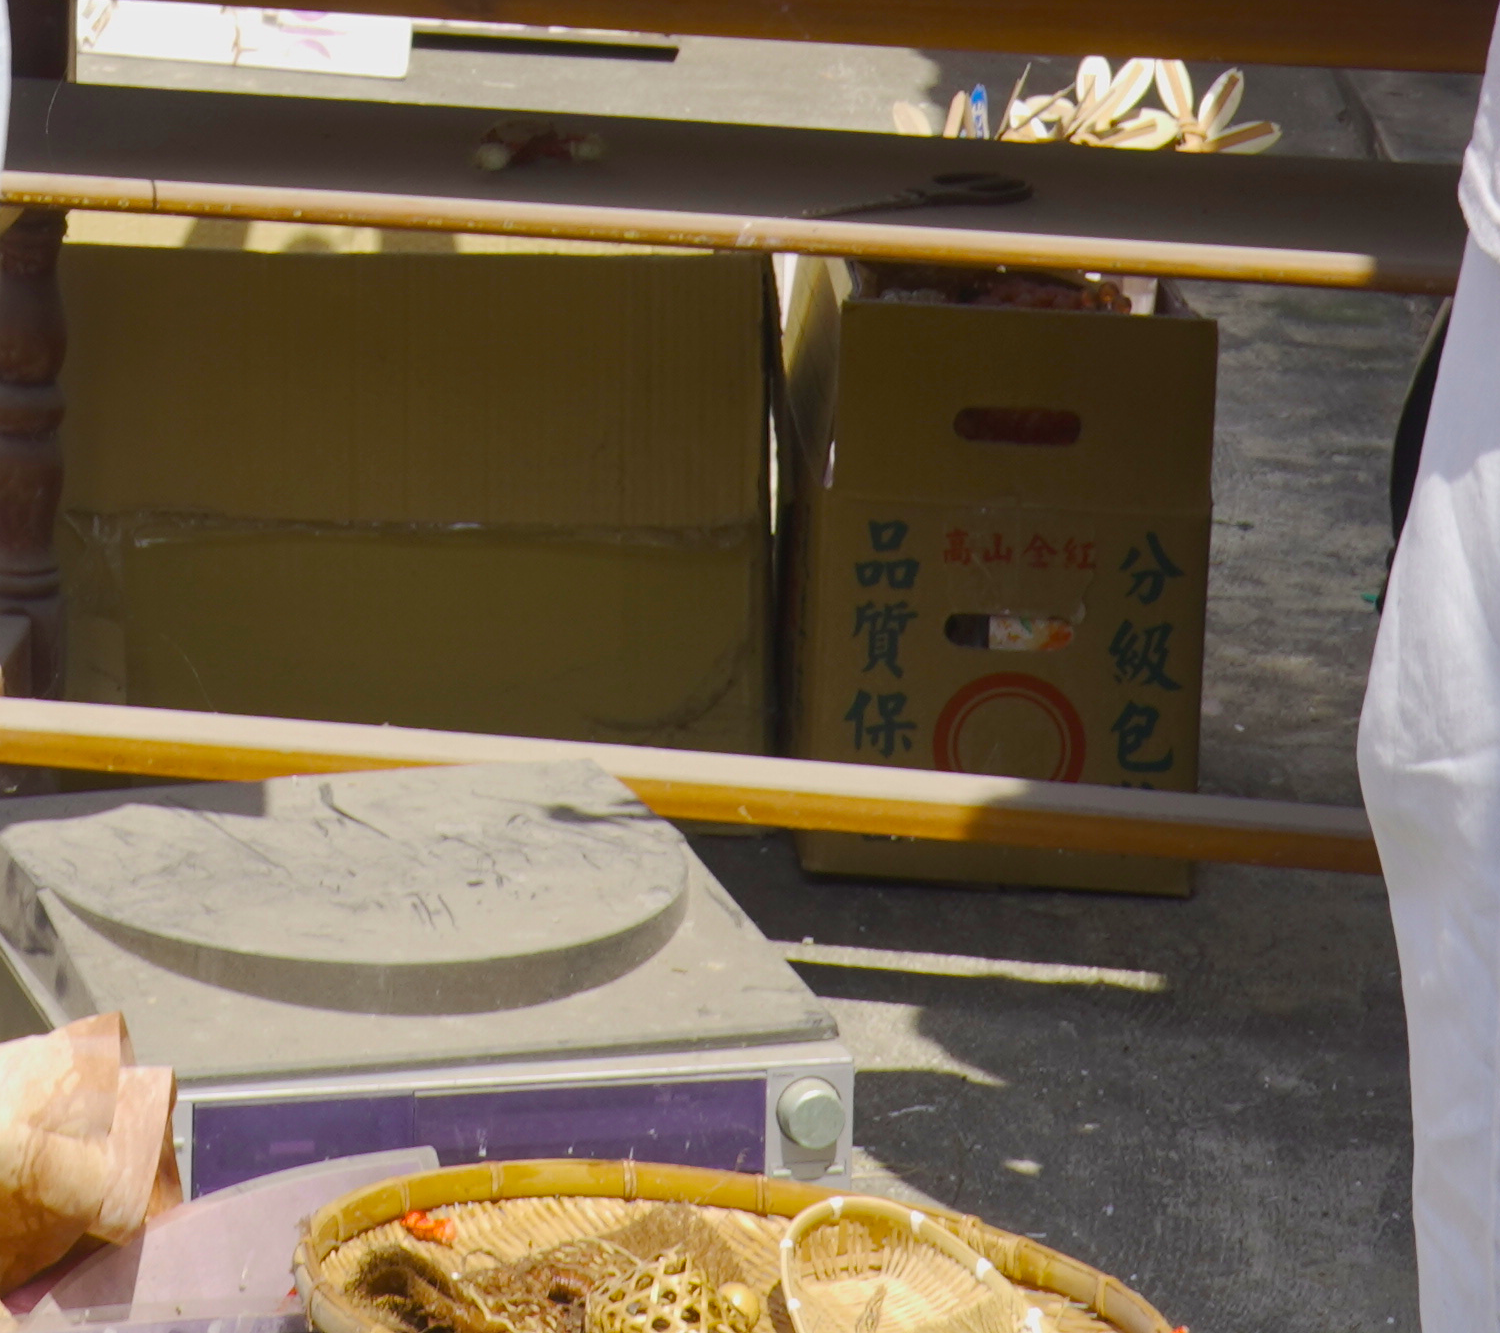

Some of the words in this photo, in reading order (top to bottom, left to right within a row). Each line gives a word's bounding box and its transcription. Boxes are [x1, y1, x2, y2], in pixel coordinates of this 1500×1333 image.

[844, 519, 921, 761] 品質保
[1108, 531, 1186, 791] 分級包
